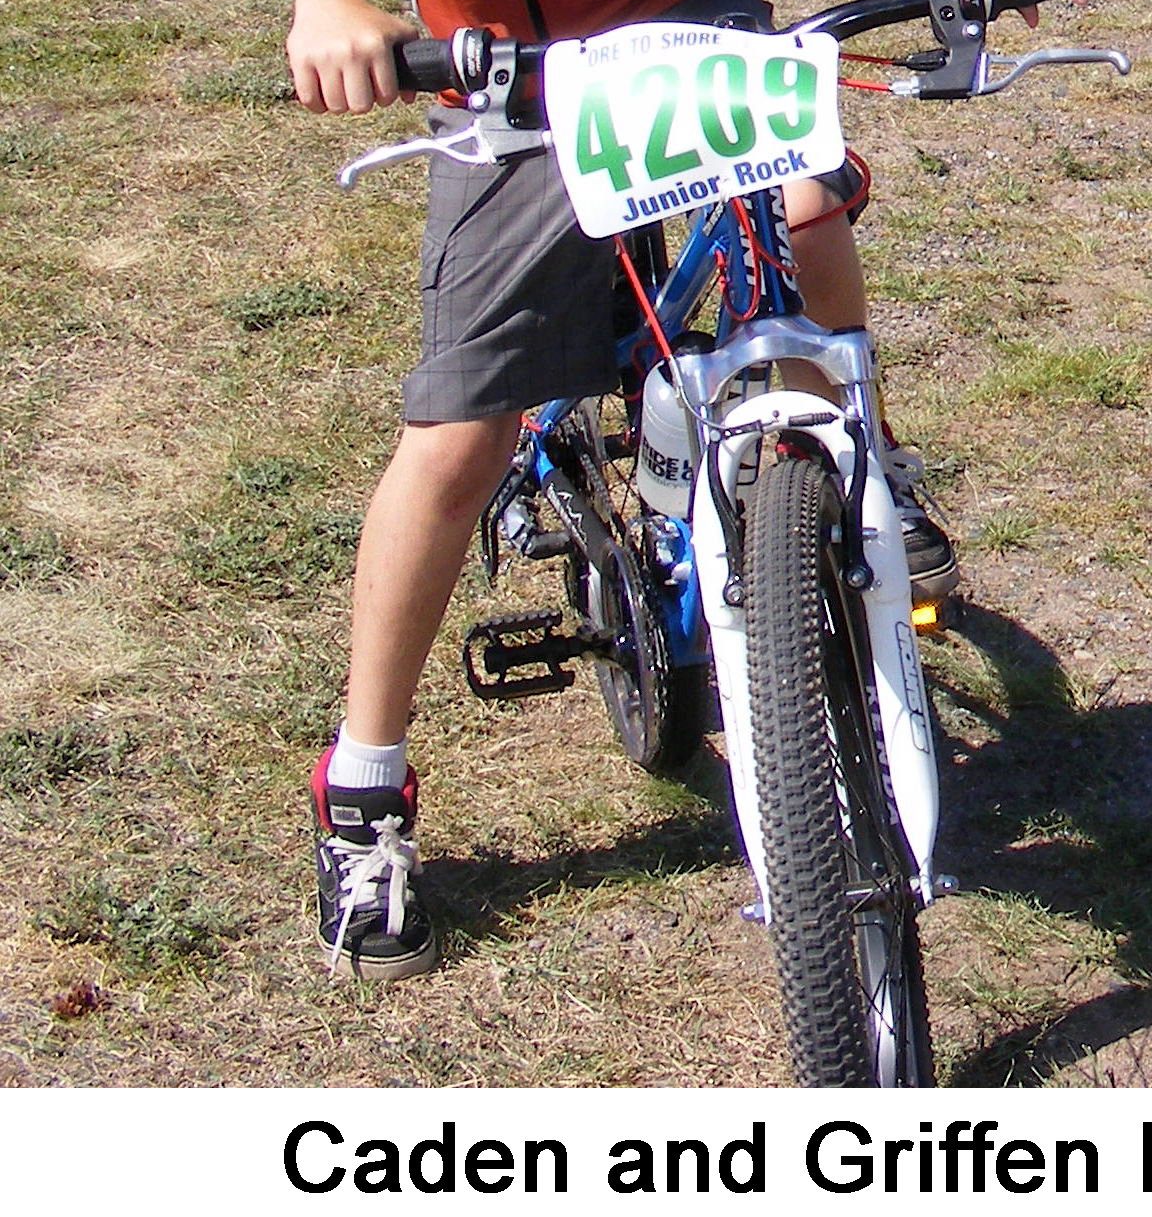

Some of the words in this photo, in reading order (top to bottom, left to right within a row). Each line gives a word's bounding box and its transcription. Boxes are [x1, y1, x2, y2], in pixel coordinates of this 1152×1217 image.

[588, 45, 620, 67] ORE
[631, 35, 651, 56] TO
[661, 33, 721, 49] SHORE
[576, 53, 818, 193] 4209
[622, 174, 722, 222] Junior
[733, 149, 809, 186] Rock
